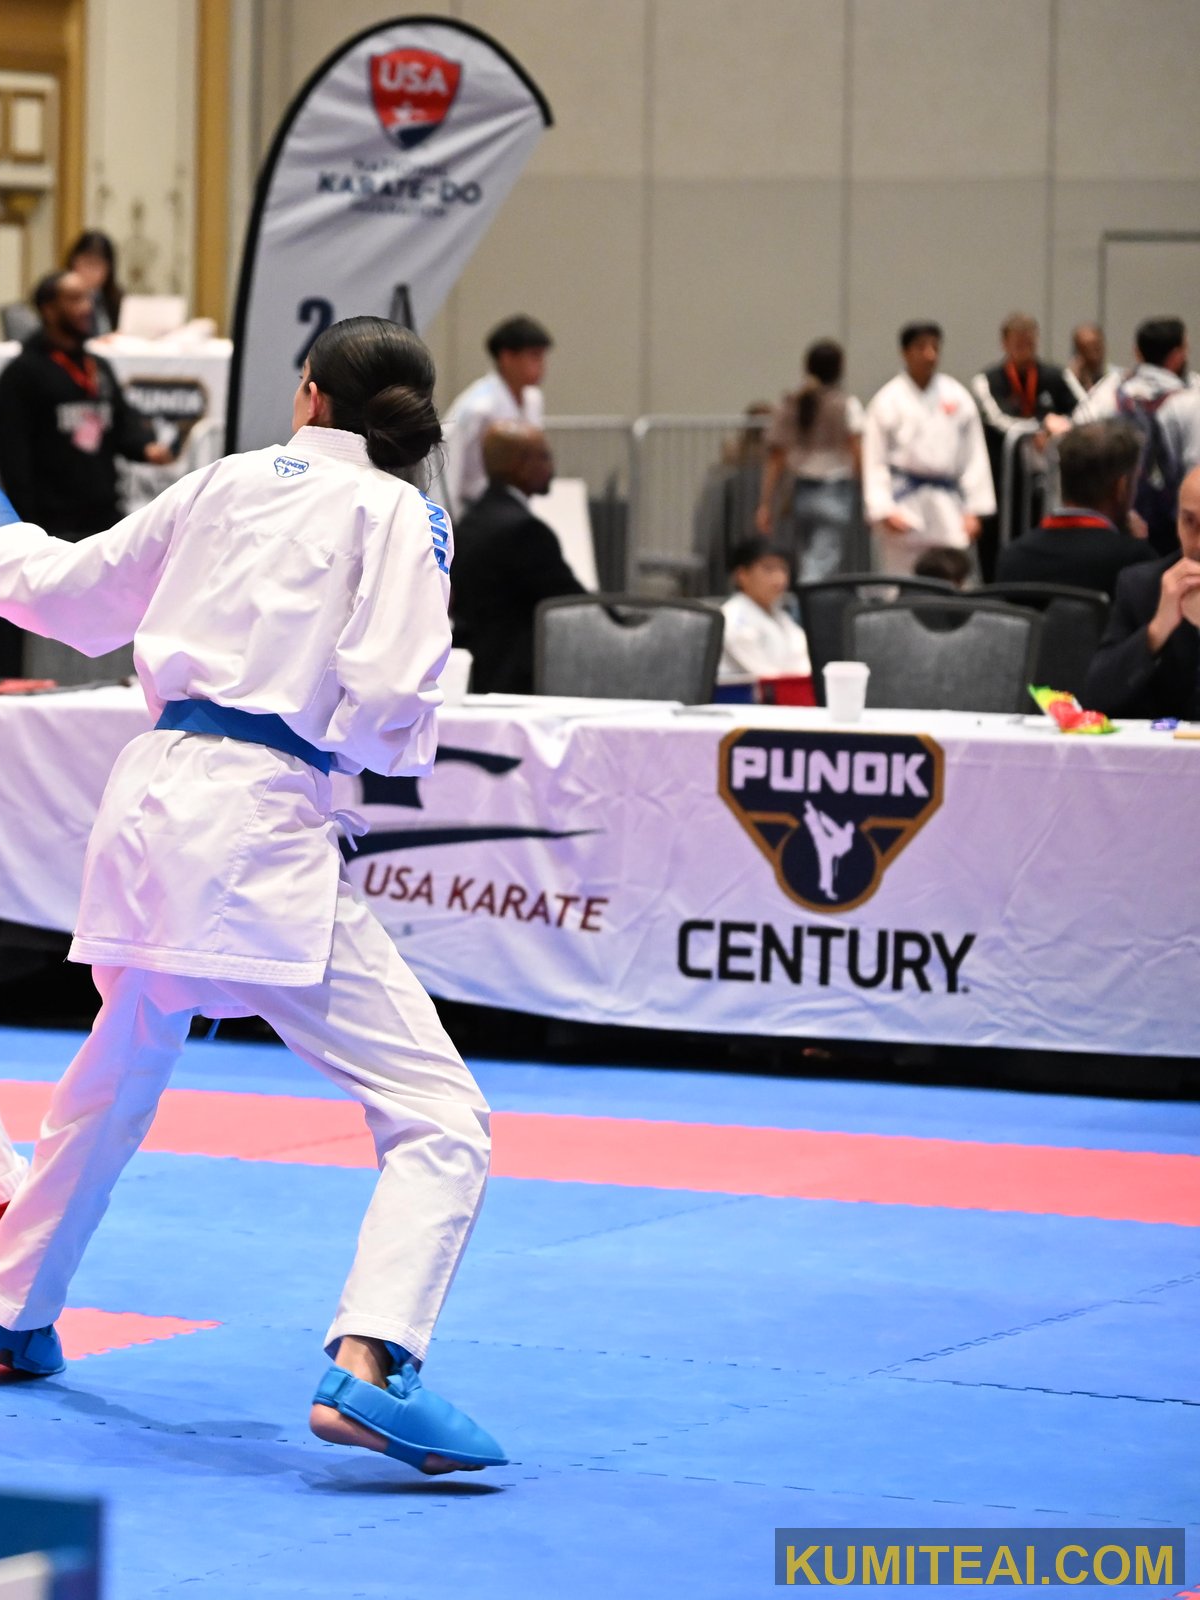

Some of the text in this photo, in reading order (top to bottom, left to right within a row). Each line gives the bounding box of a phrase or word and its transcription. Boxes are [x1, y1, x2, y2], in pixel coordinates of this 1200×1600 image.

[379, 59, 449, 97] USA
[731, 747, 929, 798] PUNOK
[363, 862, 610, 932] USA KARATE
